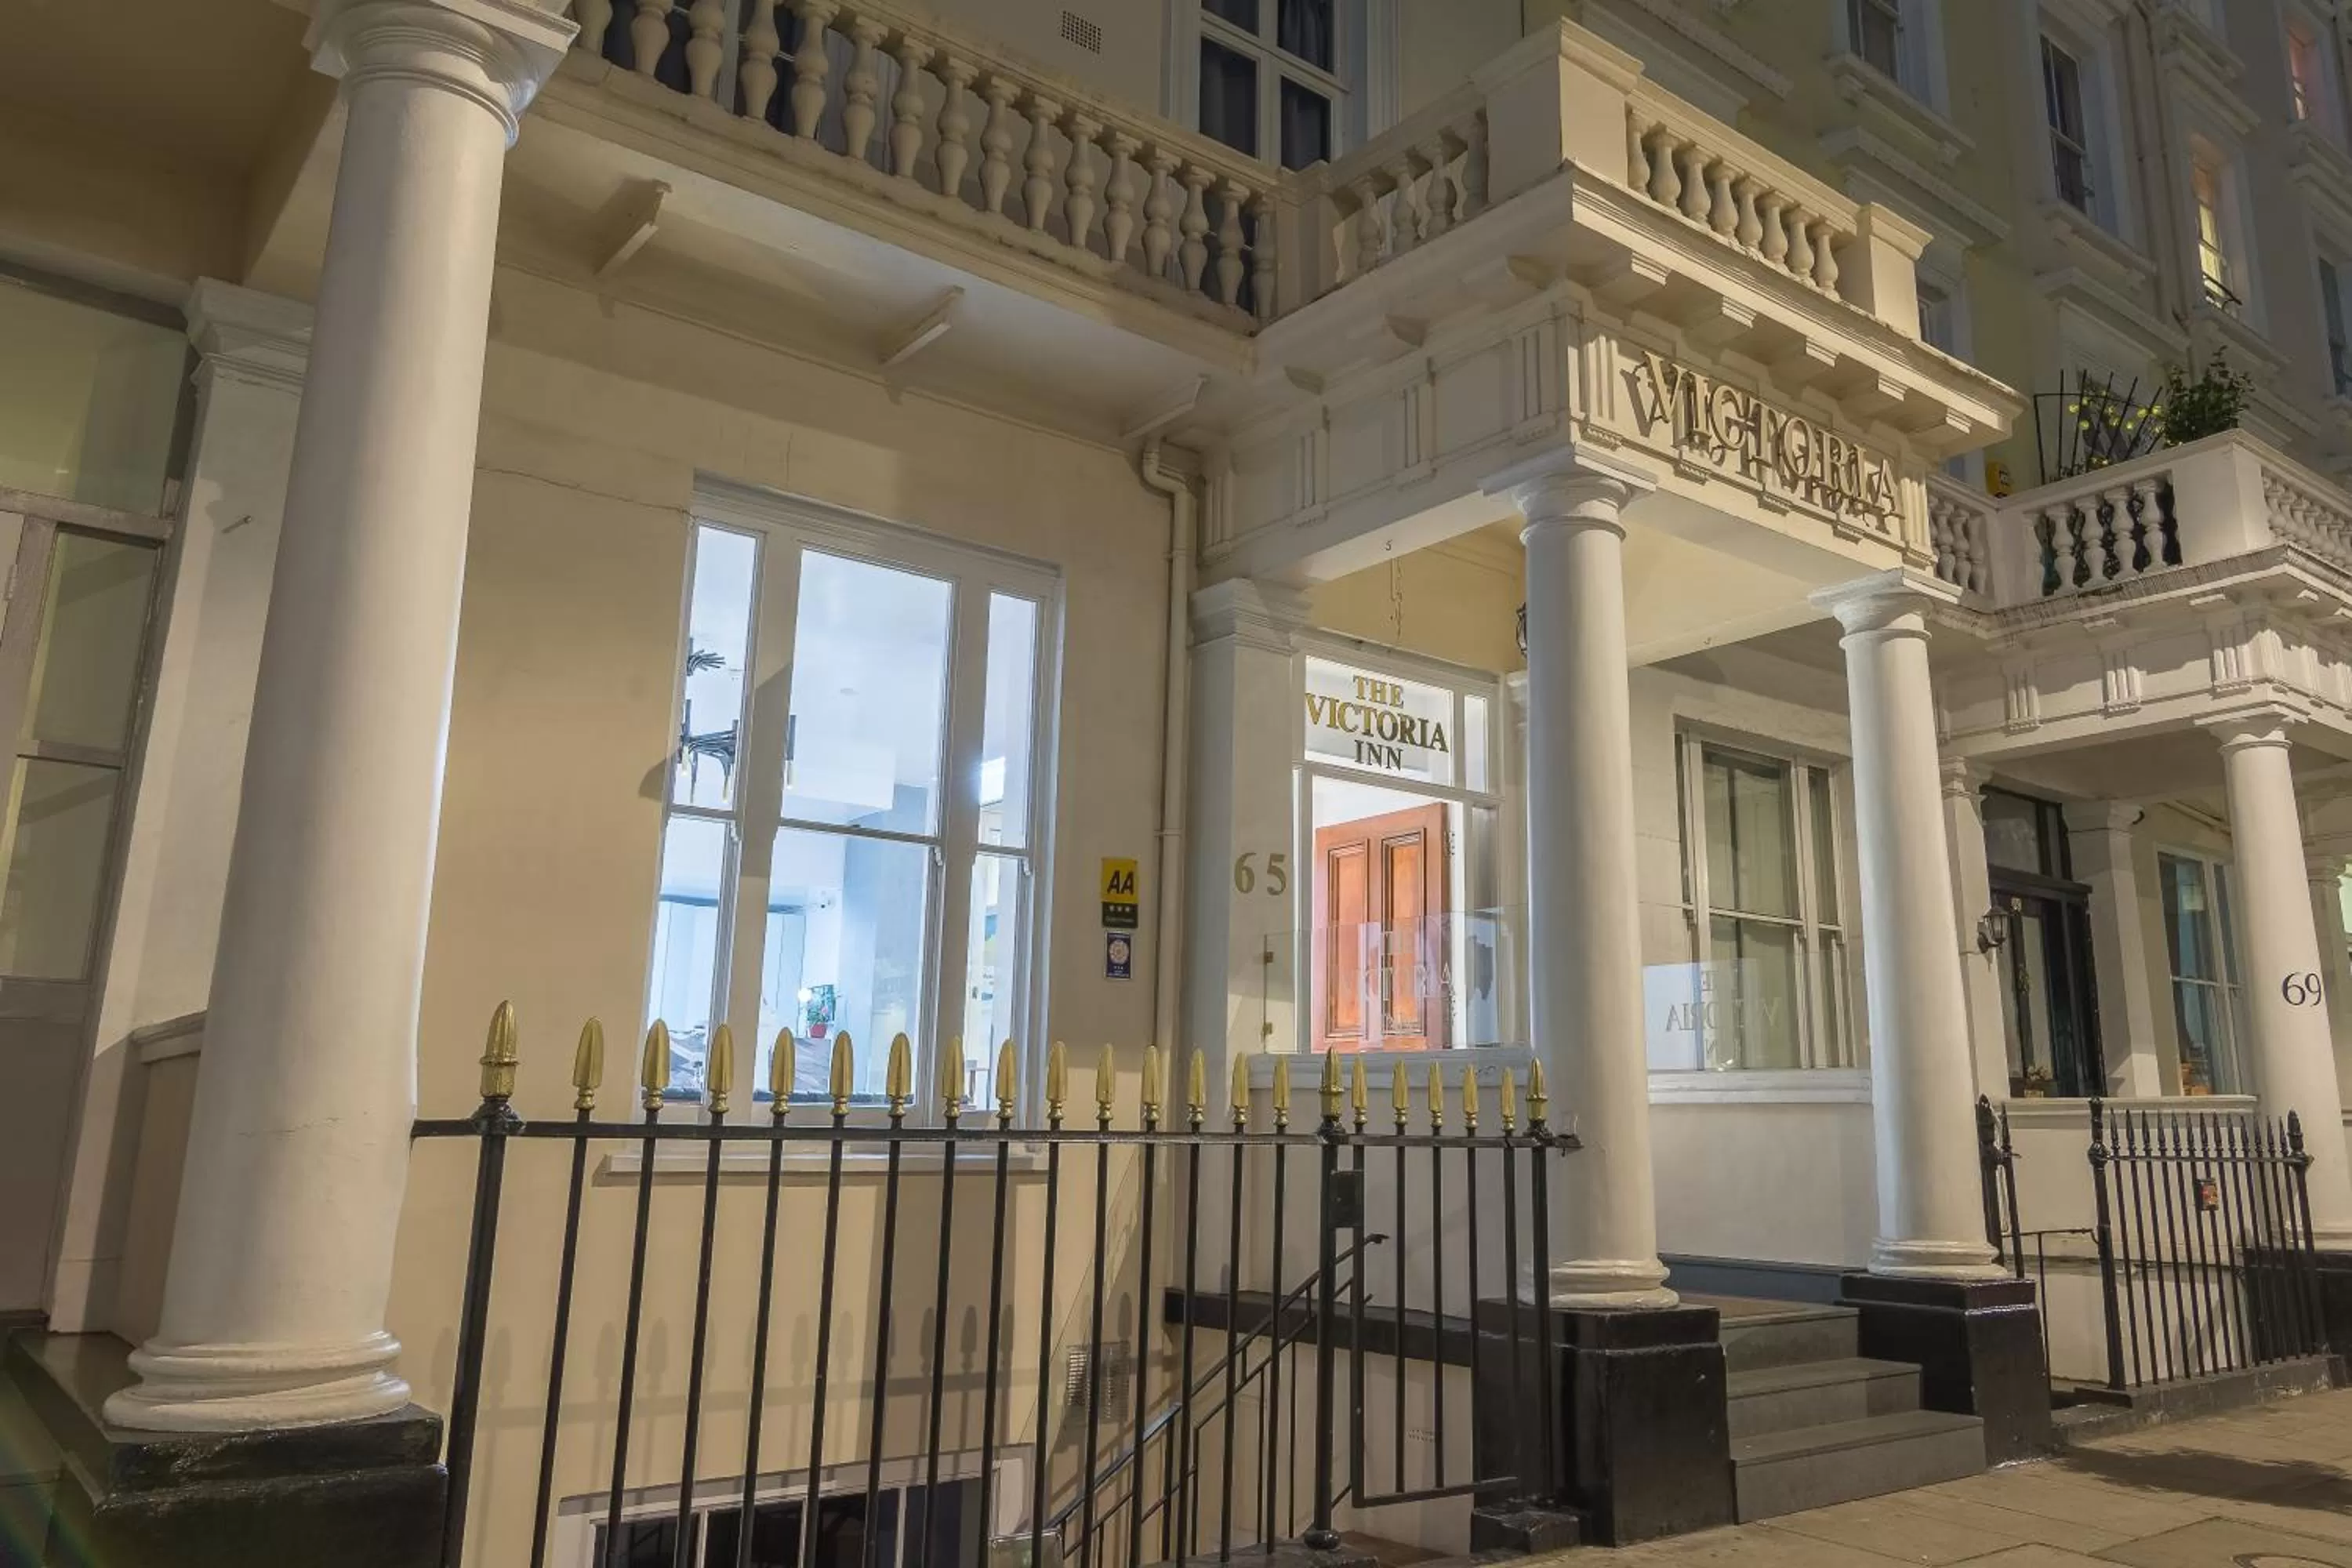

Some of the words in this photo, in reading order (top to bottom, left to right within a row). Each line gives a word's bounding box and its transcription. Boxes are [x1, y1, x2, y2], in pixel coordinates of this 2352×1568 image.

[1642, 350, 1905, 520] VICTORIA
[1352, 676, 1404, 708] THE
[1305, 692, 1450, 753] VICTORIA
[1354, 739, 1403, 771] INN
[1106, 869, 1134, 895] AA
[1234, 852, 1287, 895] 65
[2282, 972, 2321, 1007] 69
